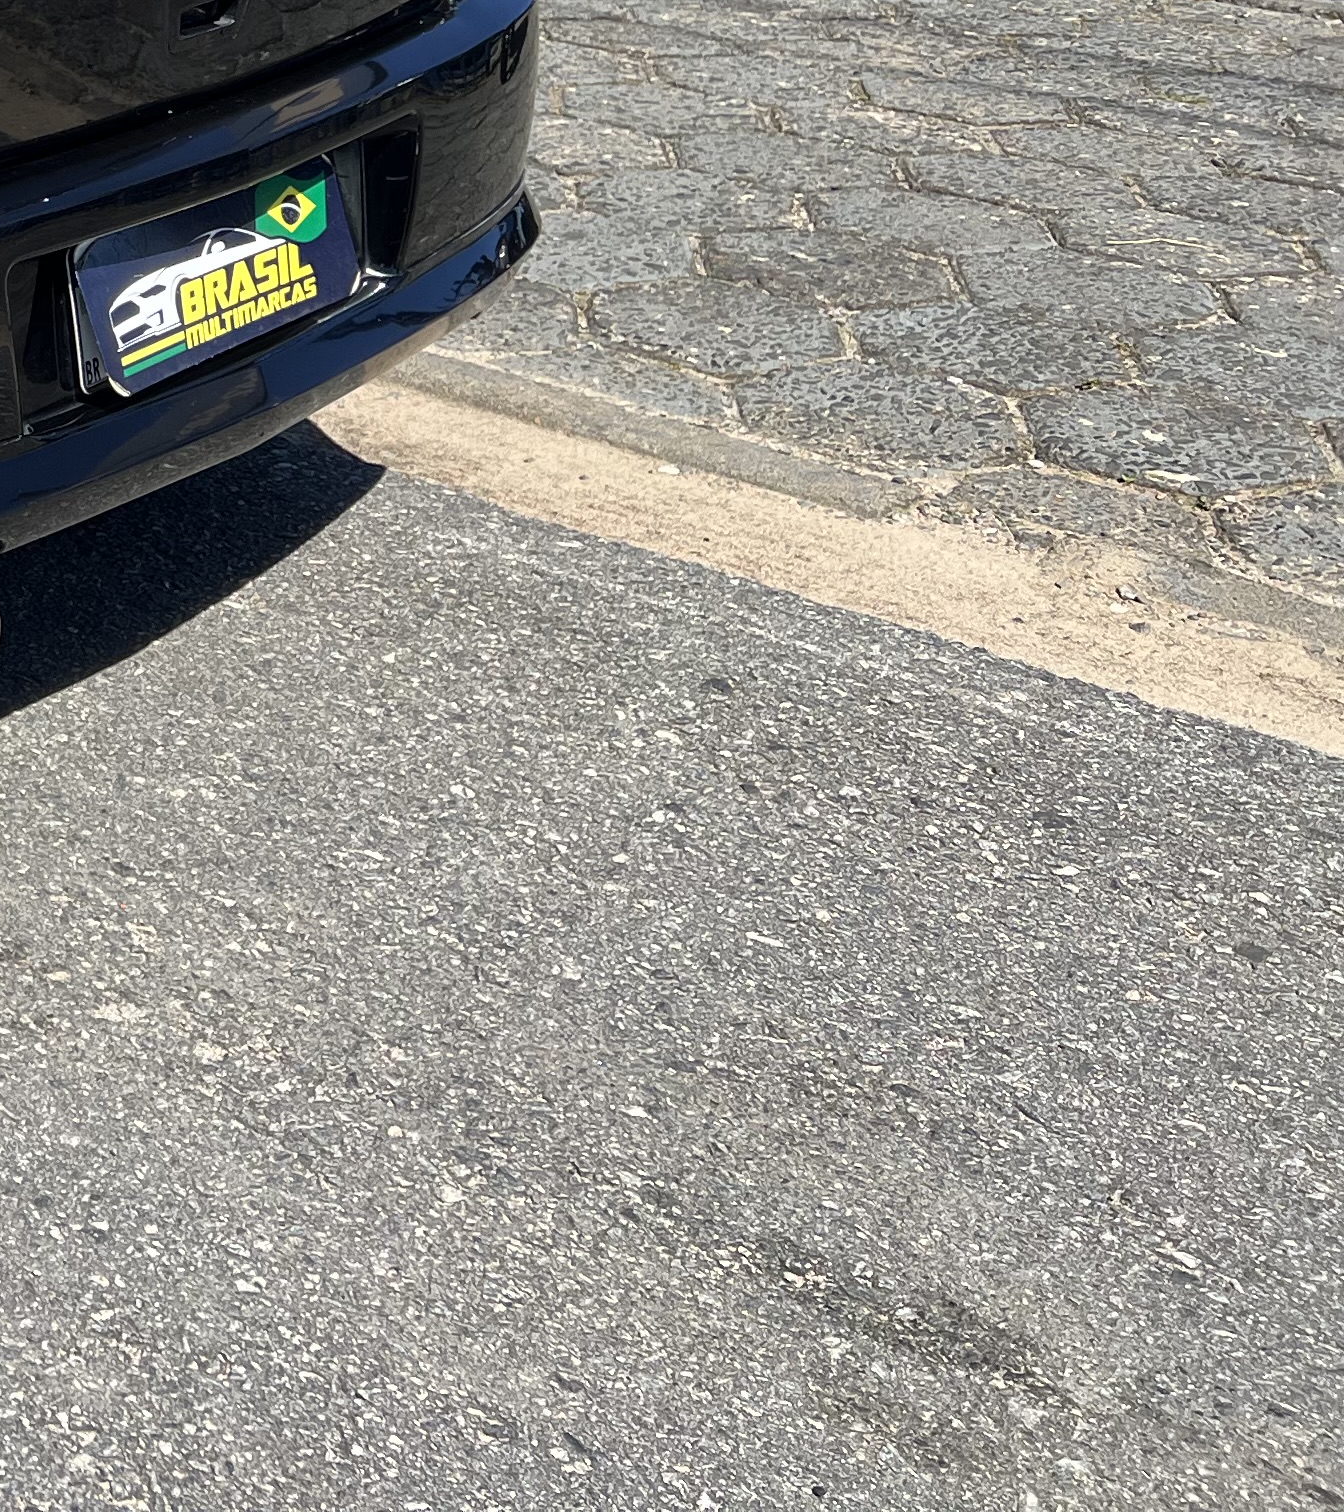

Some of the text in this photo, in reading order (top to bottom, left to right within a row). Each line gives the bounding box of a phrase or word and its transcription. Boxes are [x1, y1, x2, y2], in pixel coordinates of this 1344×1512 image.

[180, 242, 314, 326] BRASIL
[185, 276, 318, 350] MULTIMARCAS
[85, 357, 101, 386] BR
